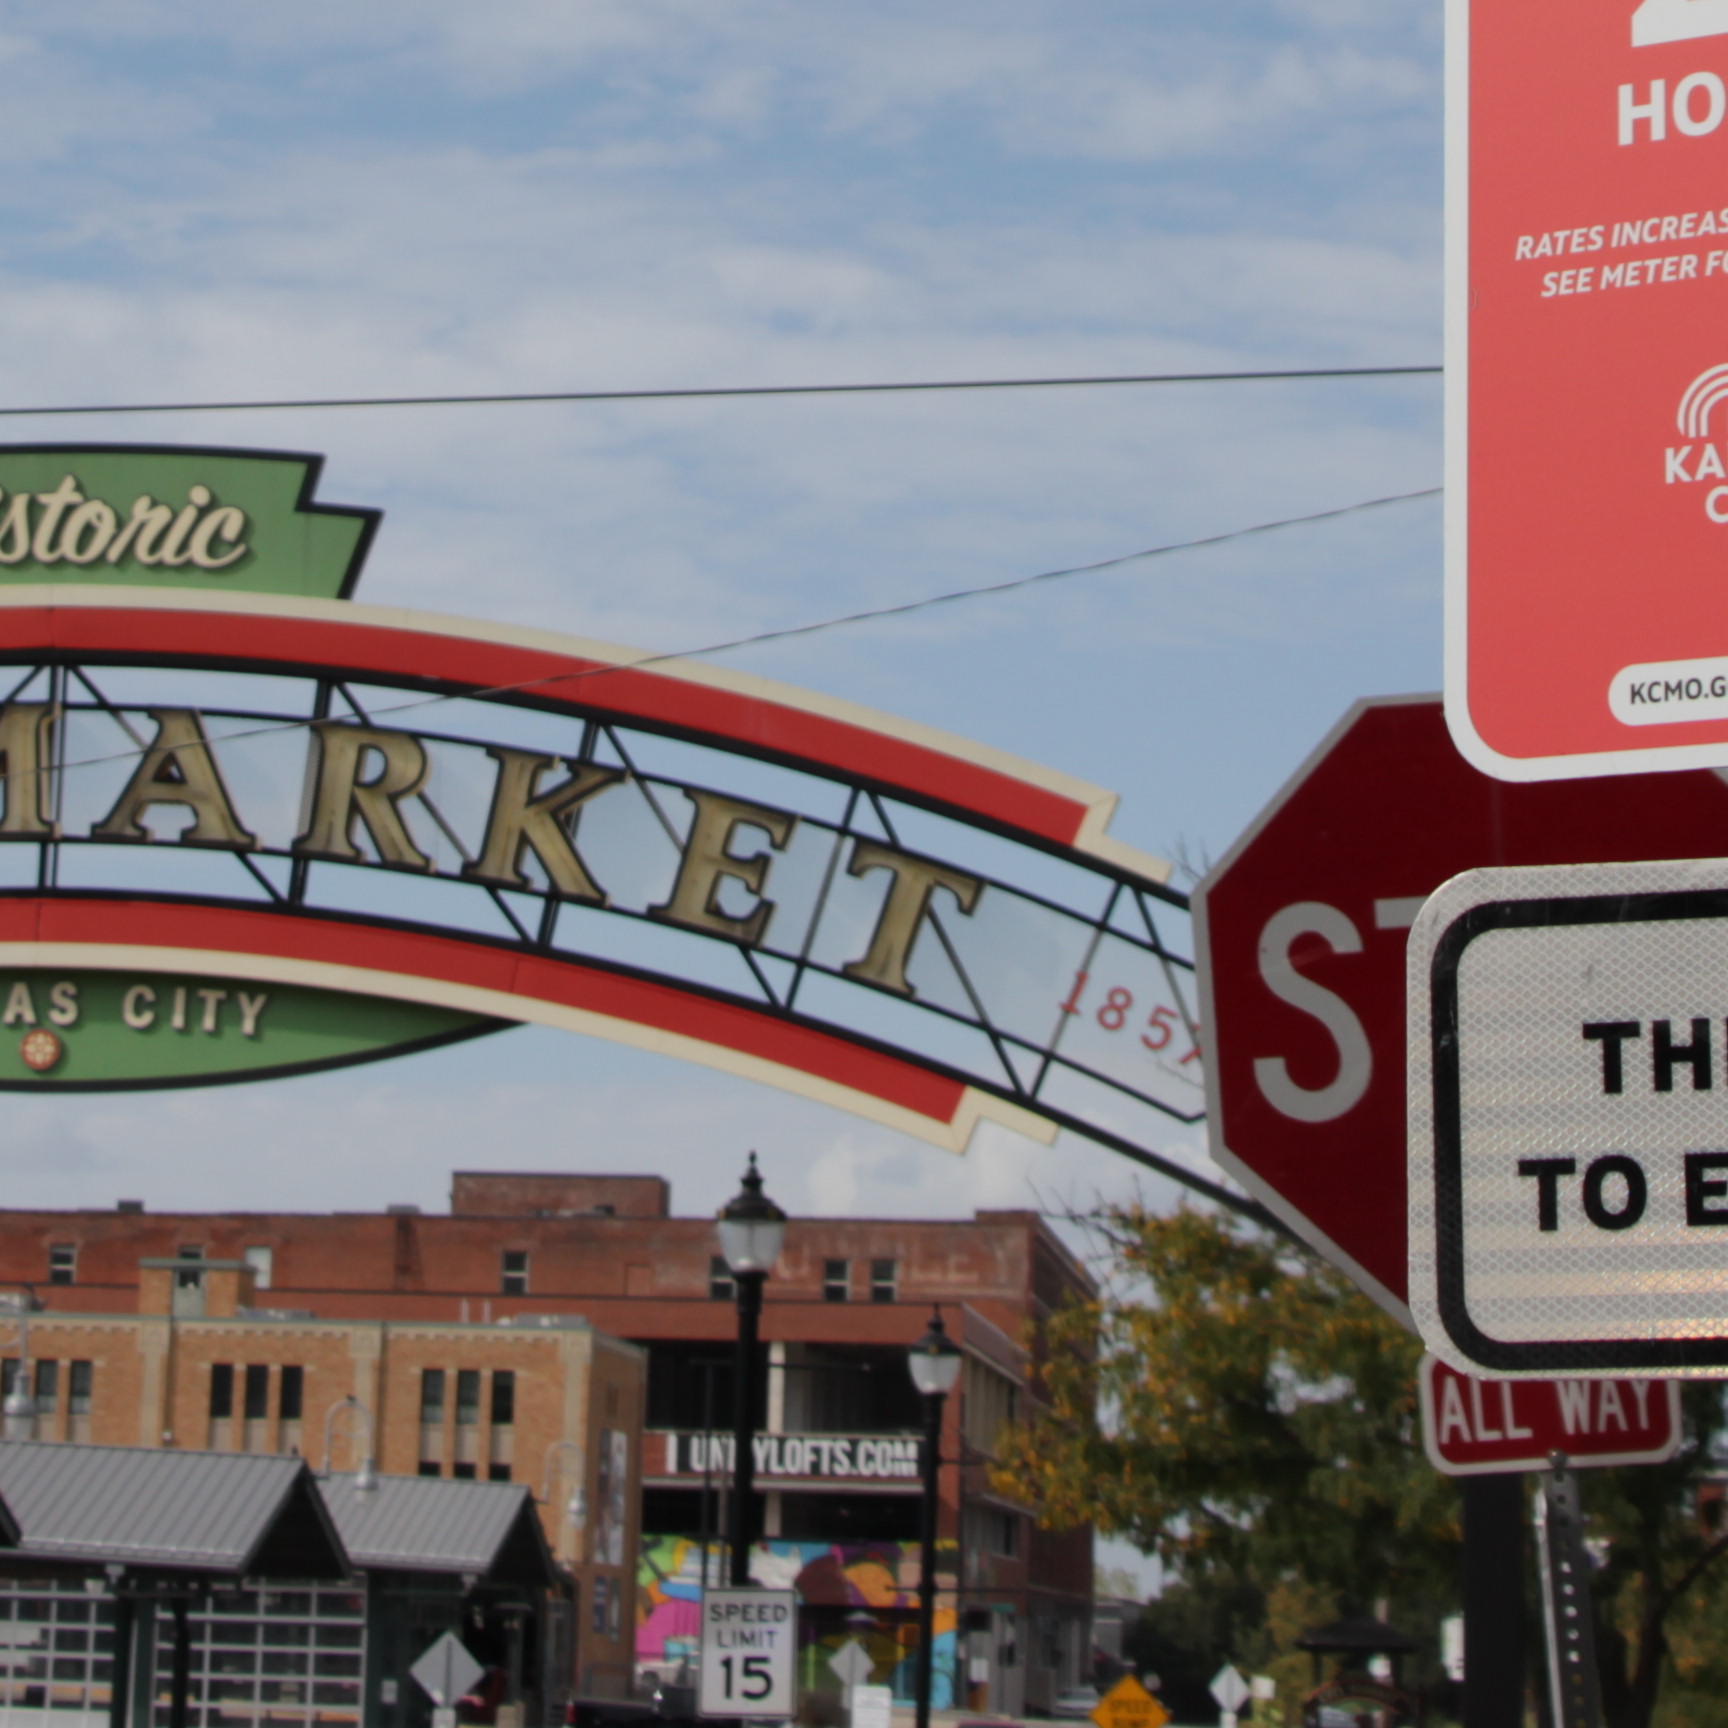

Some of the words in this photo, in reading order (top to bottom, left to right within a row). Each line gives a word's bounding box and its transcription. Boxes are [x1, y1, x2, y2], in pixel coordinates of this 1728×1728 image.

[1515, 225, 1605, 260] RATES
[1541, 267, 1593, 298] SEE
[1600, 253, 1697, 291] METER
[122, 984, 269, 1037] CITY
[1518, 1153, 1651, 1233] TO
[1439, 1373, 1533, 1445] ALL
[1555, 1379, 1651, 1436] WAY
[709, 1603, 788, 1623] SPEED
[716, 1629, 778, 1649] LIMIT
[721, 1654, 773, 1701] 15
